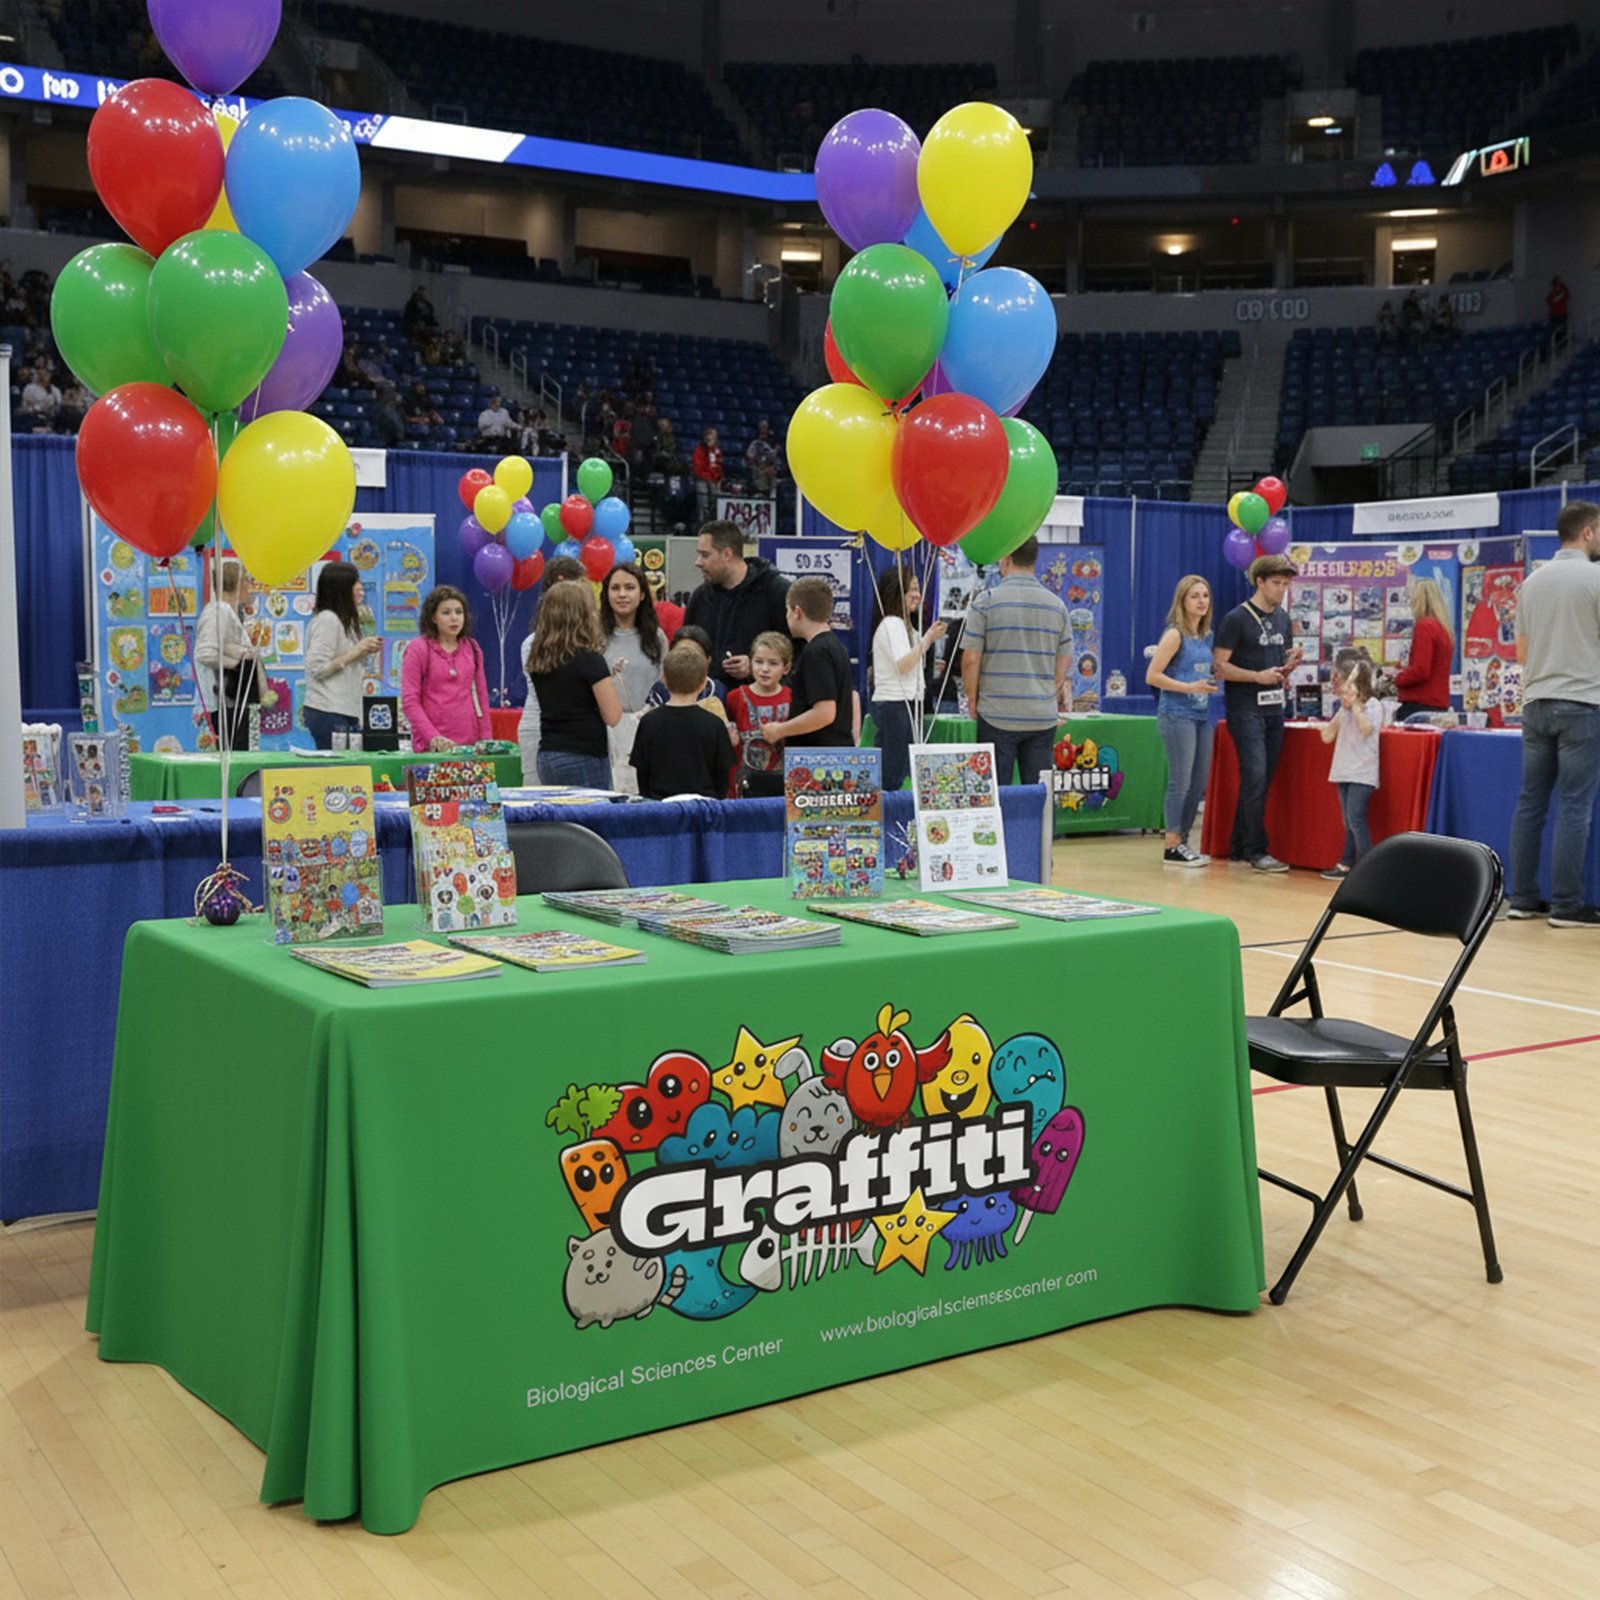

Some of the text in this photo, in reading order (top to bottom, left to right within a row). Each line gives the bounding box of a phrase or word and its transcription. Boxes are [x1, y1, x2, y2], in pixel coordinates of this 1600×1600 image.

[617, 1107, 1032, 1251] Graffiti
[526, 1338, 784, 1408] Biological Sciences Center
